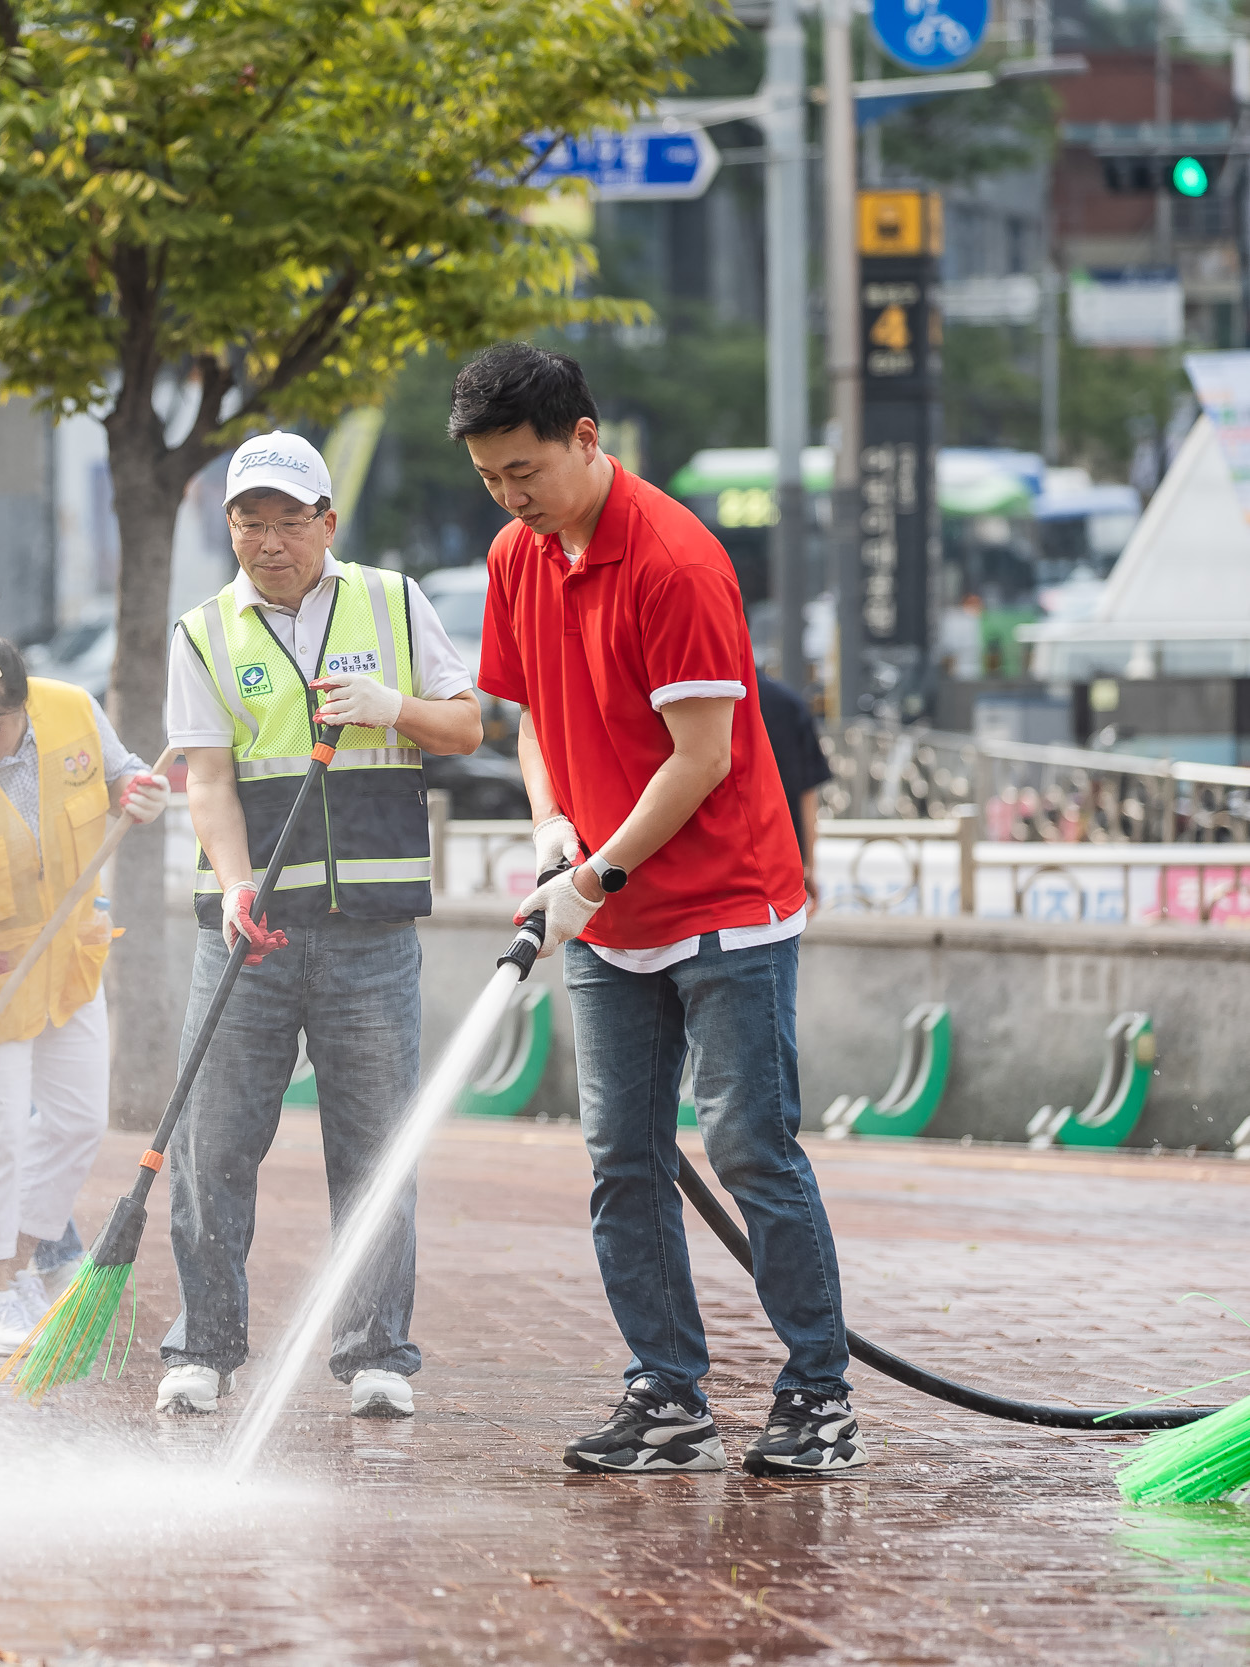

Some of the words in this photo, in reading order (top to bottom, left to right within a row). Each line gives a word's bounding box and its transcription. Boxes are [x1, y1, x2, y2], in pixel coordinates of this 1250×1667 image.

[869, 304, 912, 352] 4
[235, 449, 310, 477] Titleist
[342, 662, 376, 673] 광진구청장
[244, 684, 268, 694] 광진구
